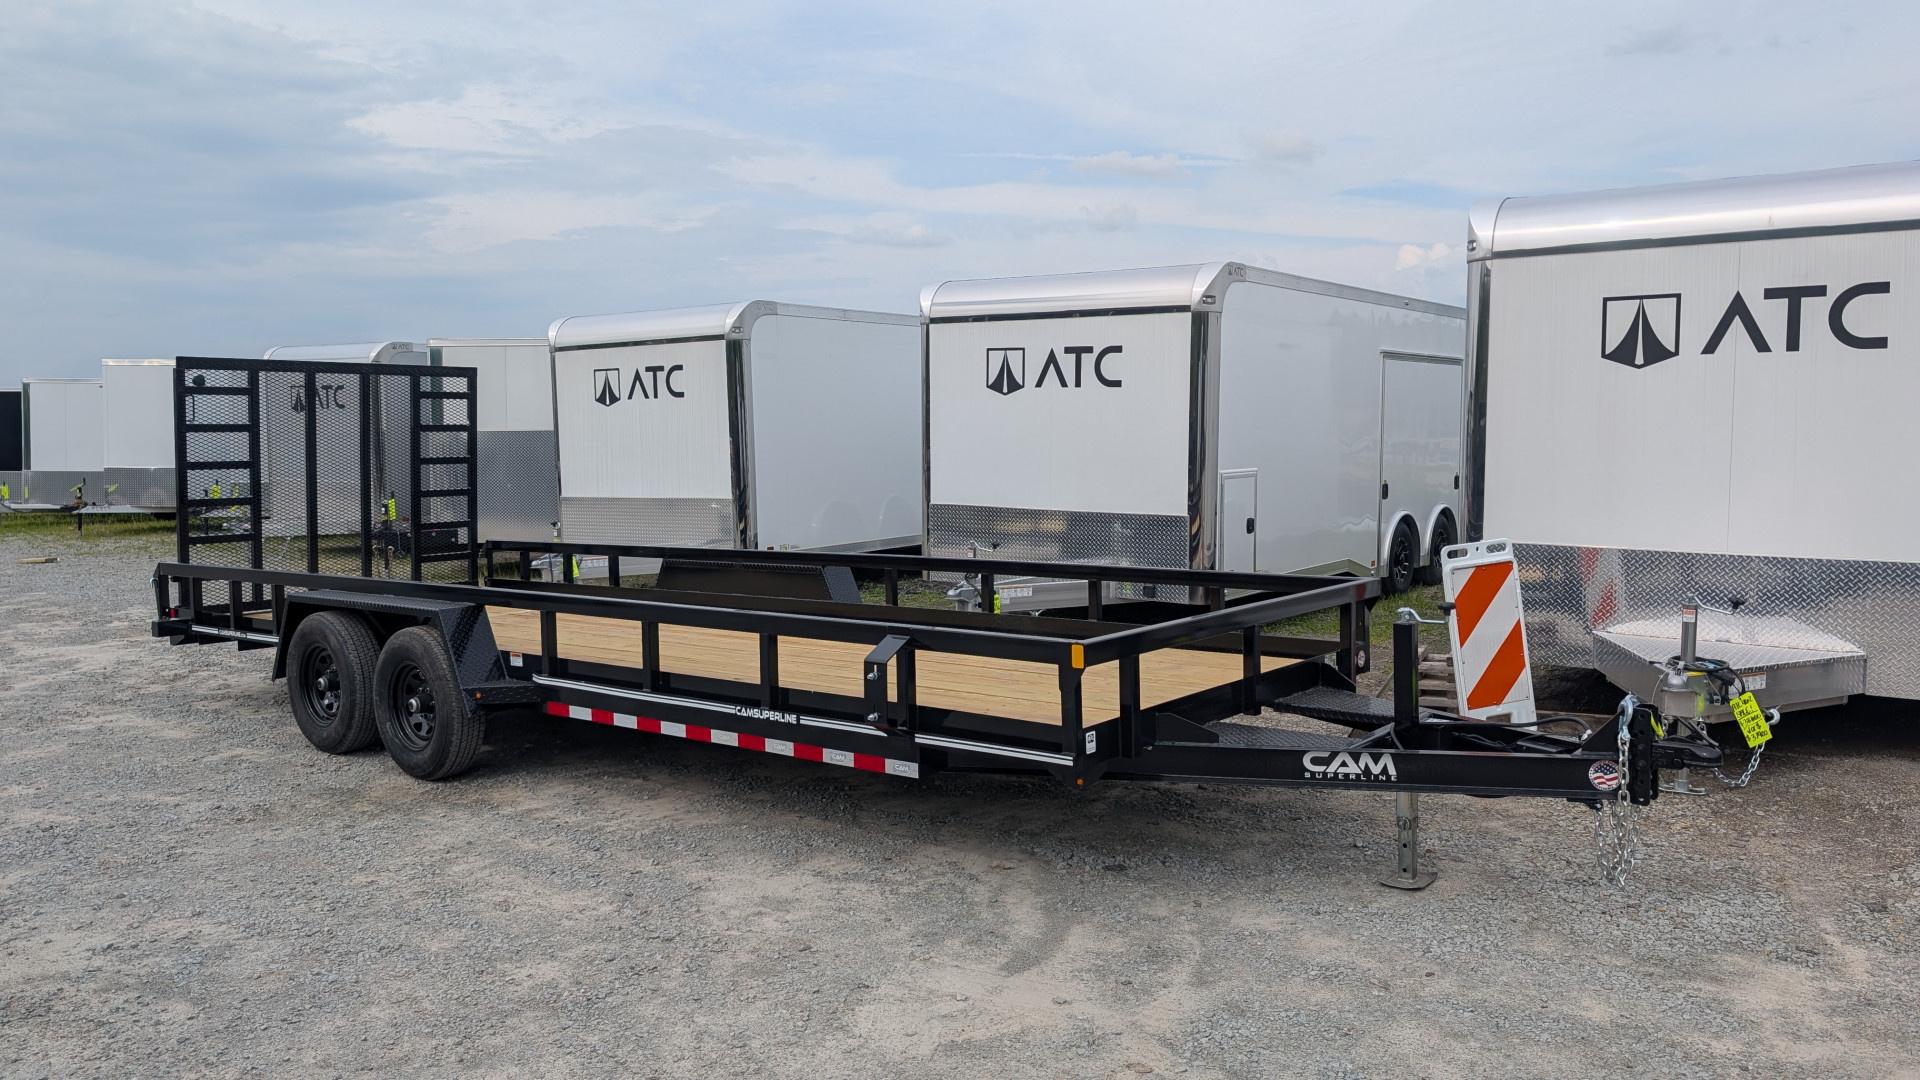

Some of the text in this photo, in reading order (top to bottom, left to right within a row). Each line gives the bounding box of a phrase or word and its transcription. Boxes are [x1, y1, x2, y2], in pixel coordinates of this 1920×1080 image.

[1700, 281, 1890, 355] ATC
[1034, 345, 1123, 388] ATC
[627, 365, 685, 400] ATC
[736, 706, 797, 724] CAMSUPERLINE
[894, 764, 909, 772] CAM
[1302, 751, 1397, 776] CAM
[1304, 772, 1398, 781] SUPERLINE
